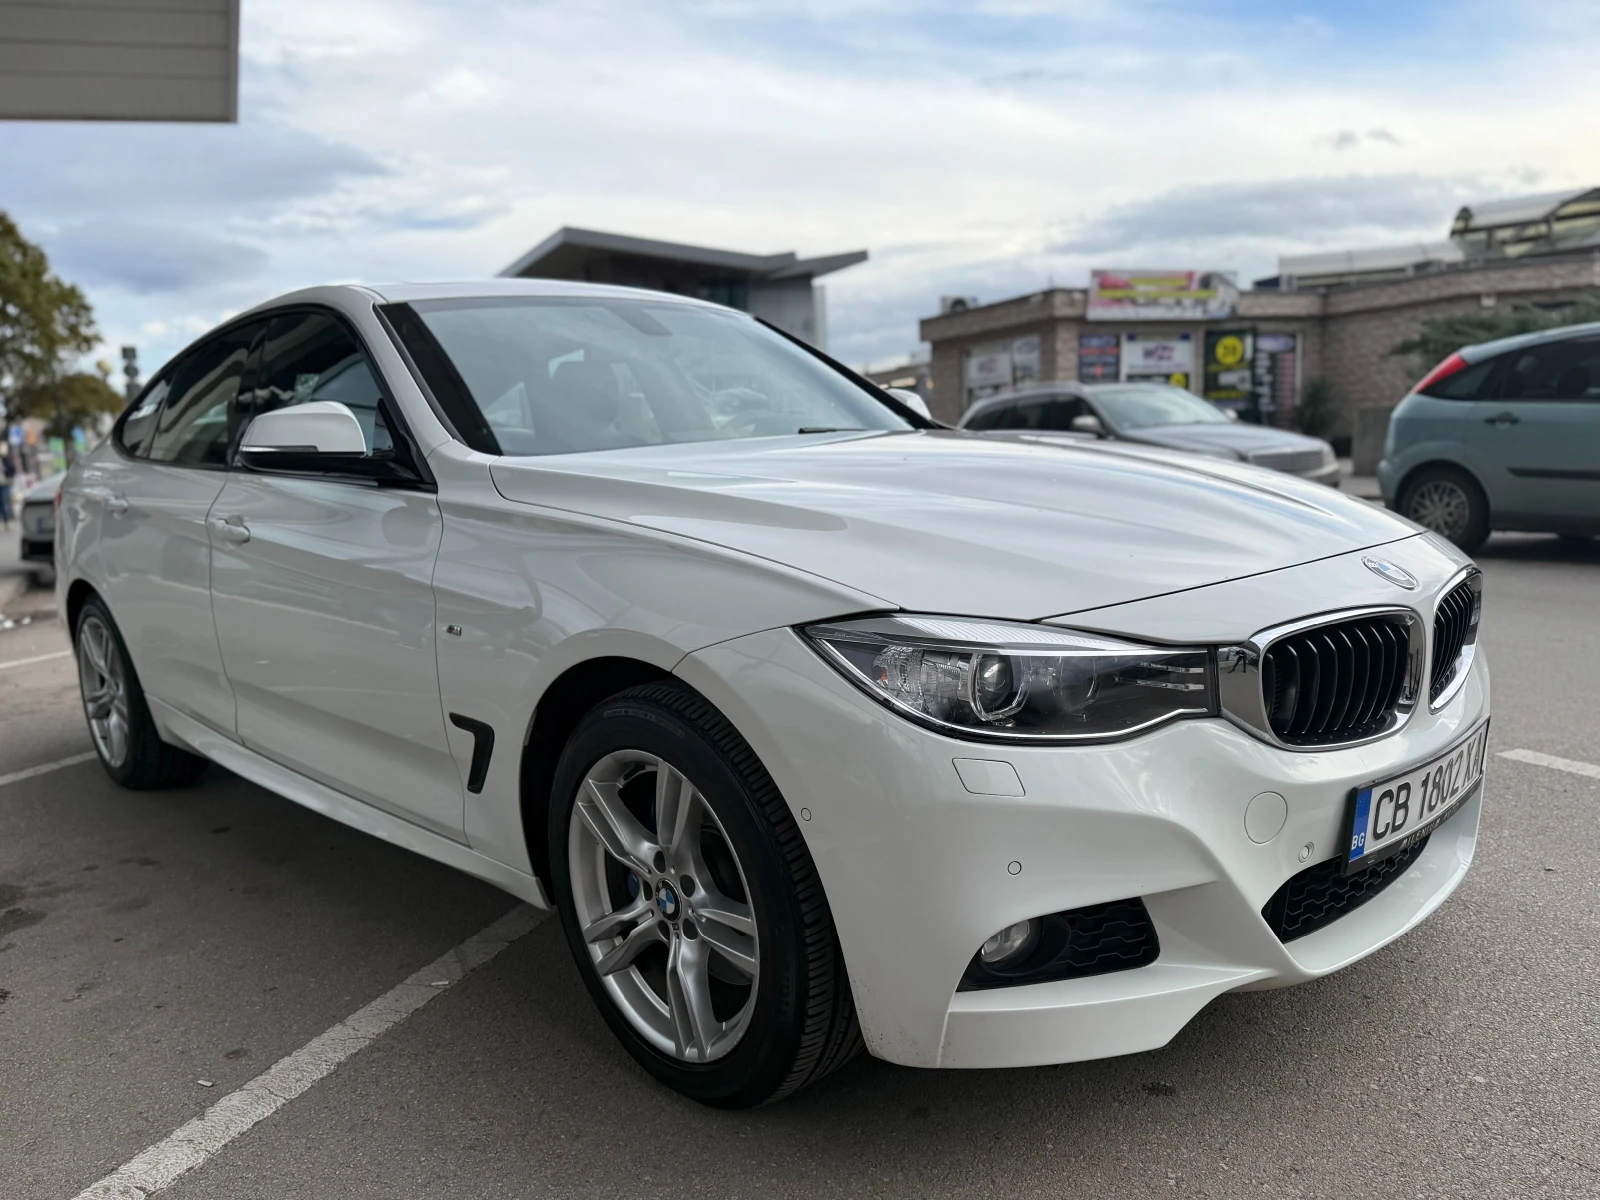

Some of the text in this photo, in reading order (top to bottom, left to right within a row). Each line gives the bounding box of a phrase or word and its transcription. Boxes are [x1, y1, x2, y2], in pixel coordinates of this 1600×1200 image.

[1373, 731, 1482, 840] CB 1802 XA
[1351, 832, 1365, 851] BG
